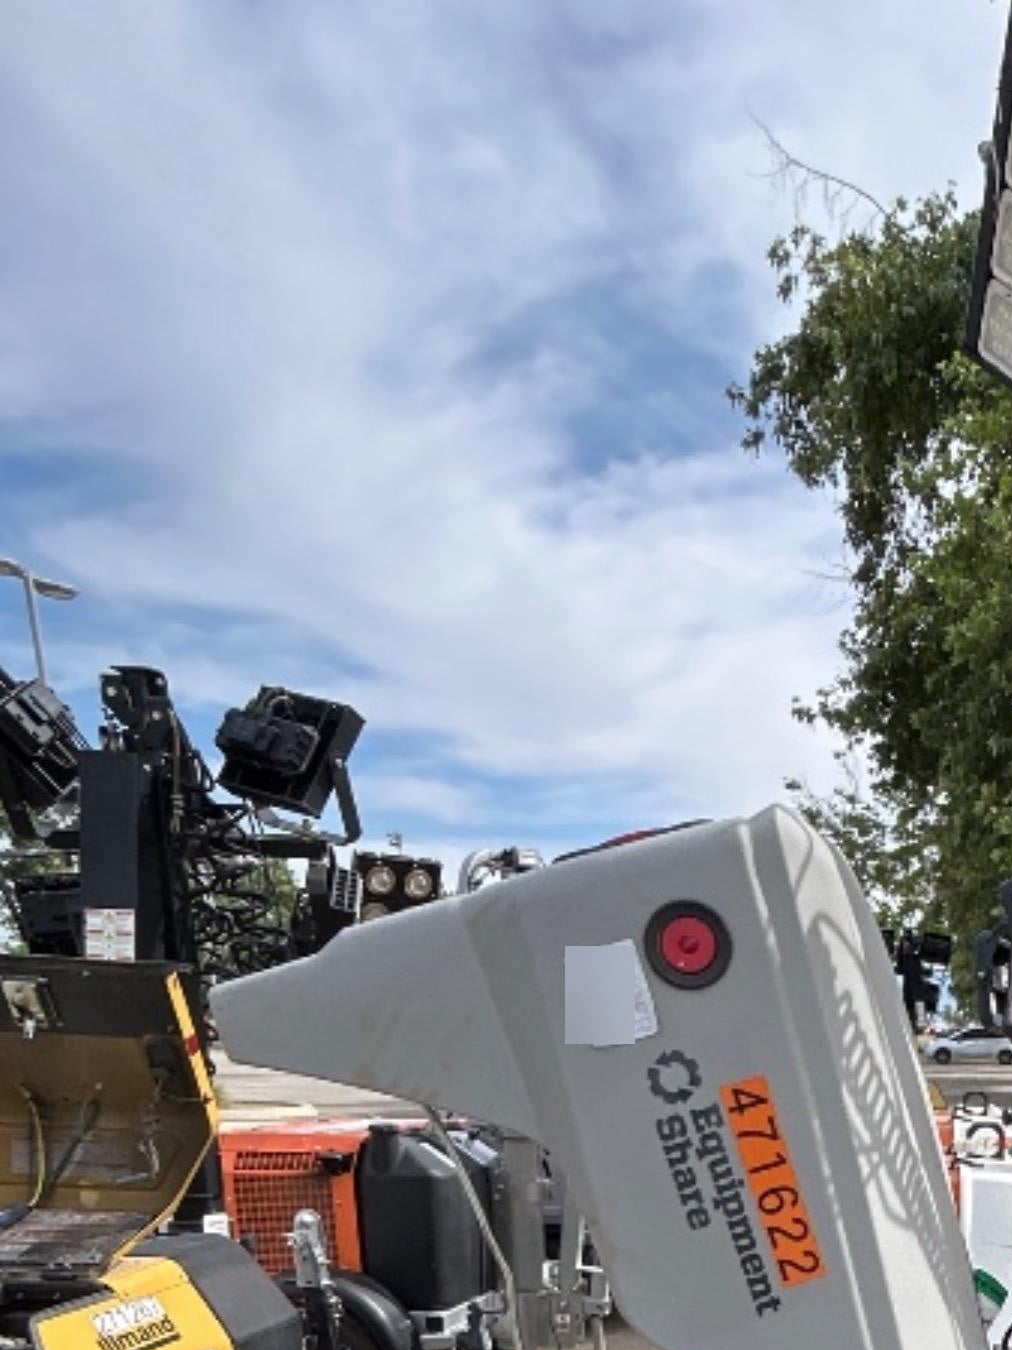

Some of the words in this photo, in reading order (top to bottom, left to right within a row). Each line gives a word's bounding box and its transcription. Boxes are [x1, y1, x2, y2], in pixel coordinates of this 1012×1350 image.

[656, 1112, 711, 1232] Share
[689, 1102, 783, 1318] Equipment
[728, 1086, 821, 1283] 471622
